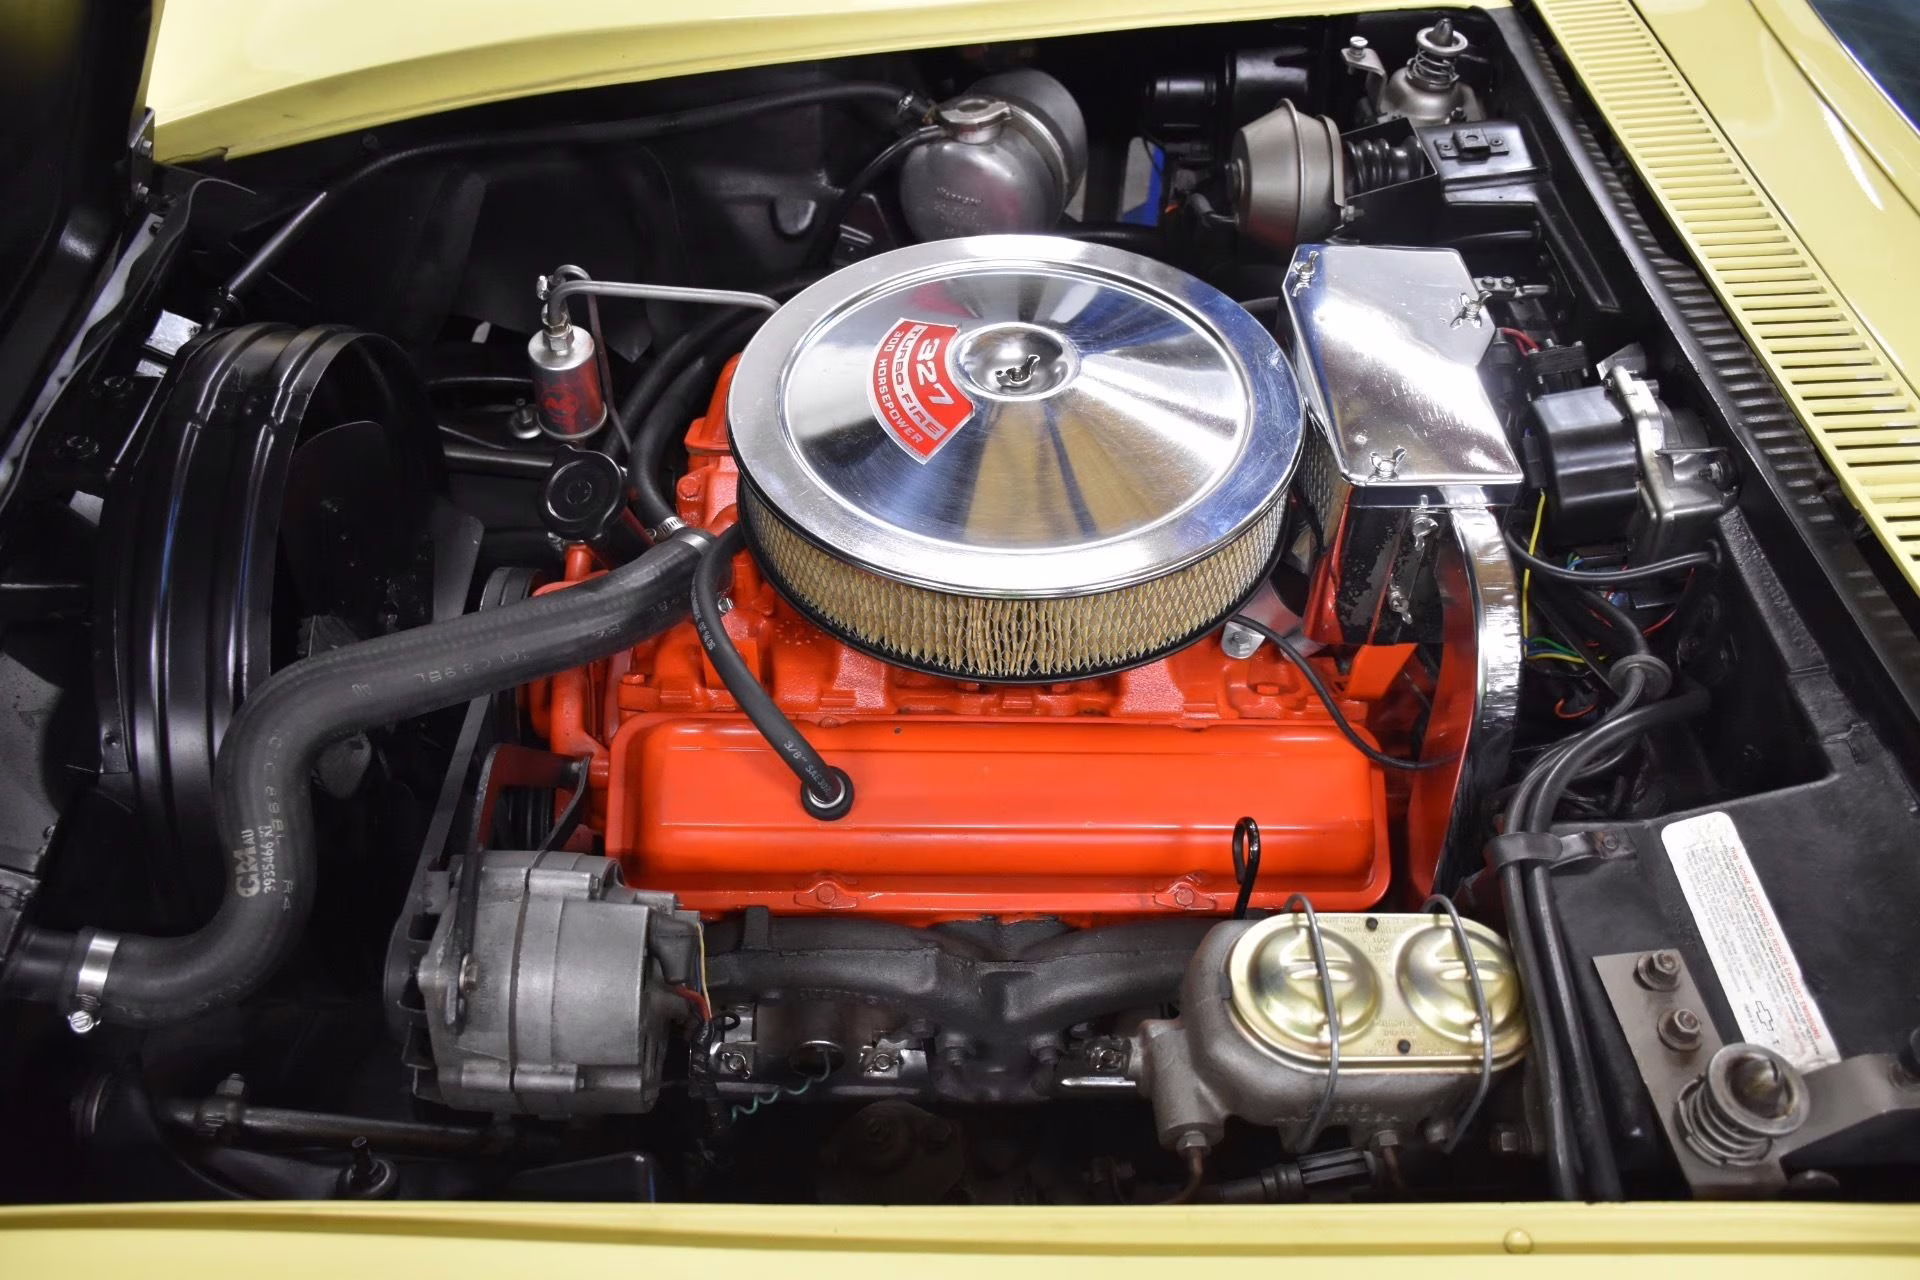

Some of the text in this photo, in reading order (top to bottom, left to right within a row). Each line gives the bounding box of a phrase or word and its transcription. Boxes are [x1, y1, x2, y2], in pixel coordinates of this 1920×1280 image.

[878, 331, 924, 443] 300 HORSEPOWER
[895, 328, 942, 436] TURBO-FIRE
[916, 338, 954, 405] 327
[233, 846, 261, 898] GM
[260, 841, 276, 894] 3935466
[1730, 847, 1739, 860] THIS
[1751, 894, 1769, 926] EQUIPPED
[1767, 928, 1774, 937] TO
[1772, 939, 1787, 966] REDUCE
[1785, 967, 1802, 999] EXHAUST
[1800, 1001, 1821, 1040] EMISSIONS
